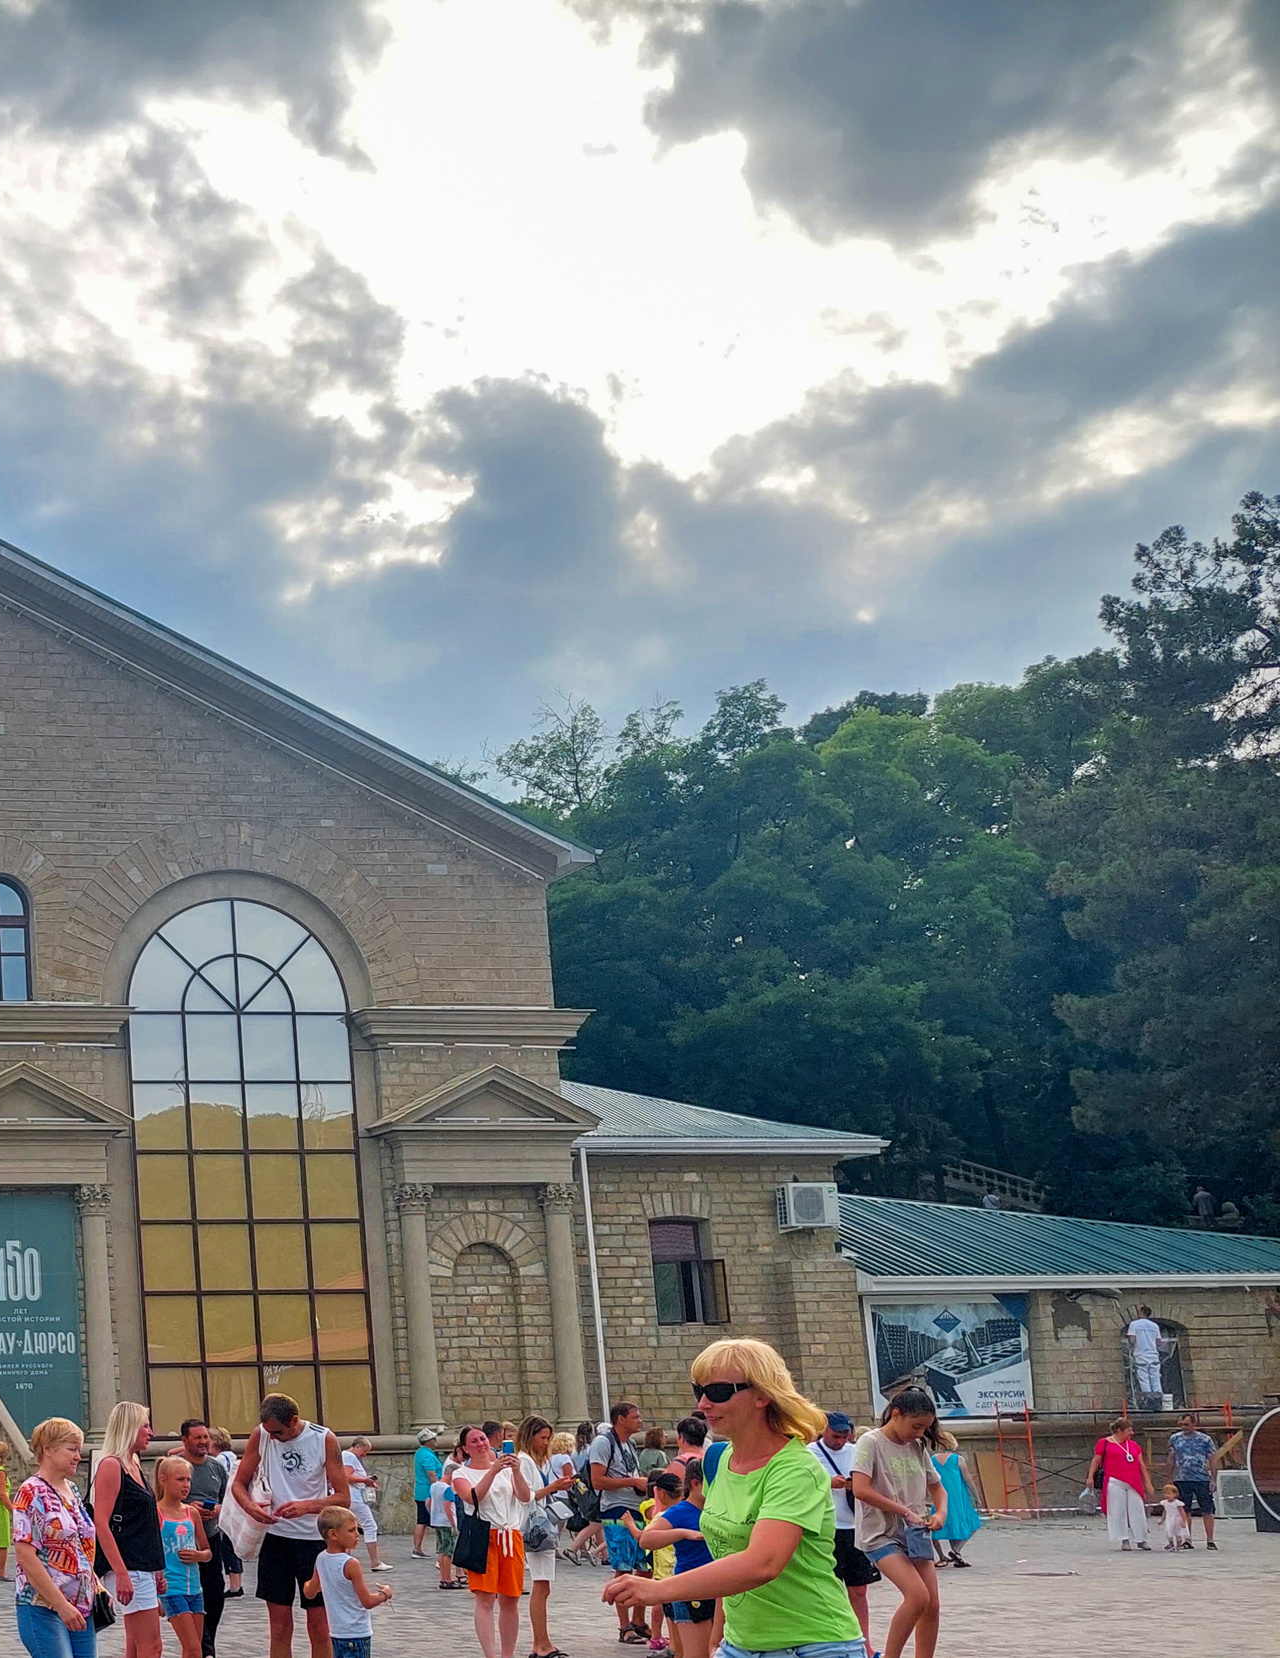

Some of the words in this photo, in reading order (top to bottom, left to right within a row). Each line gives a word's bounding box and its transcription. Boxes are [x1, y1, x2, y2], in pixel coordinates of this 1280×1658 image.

[24, 1315, 61, 1323] ИСТОРИИ
[14, 1382, 34, 1390] 1870
[977, 1389, 1026, 1399] ЭКСКУРСИИ
